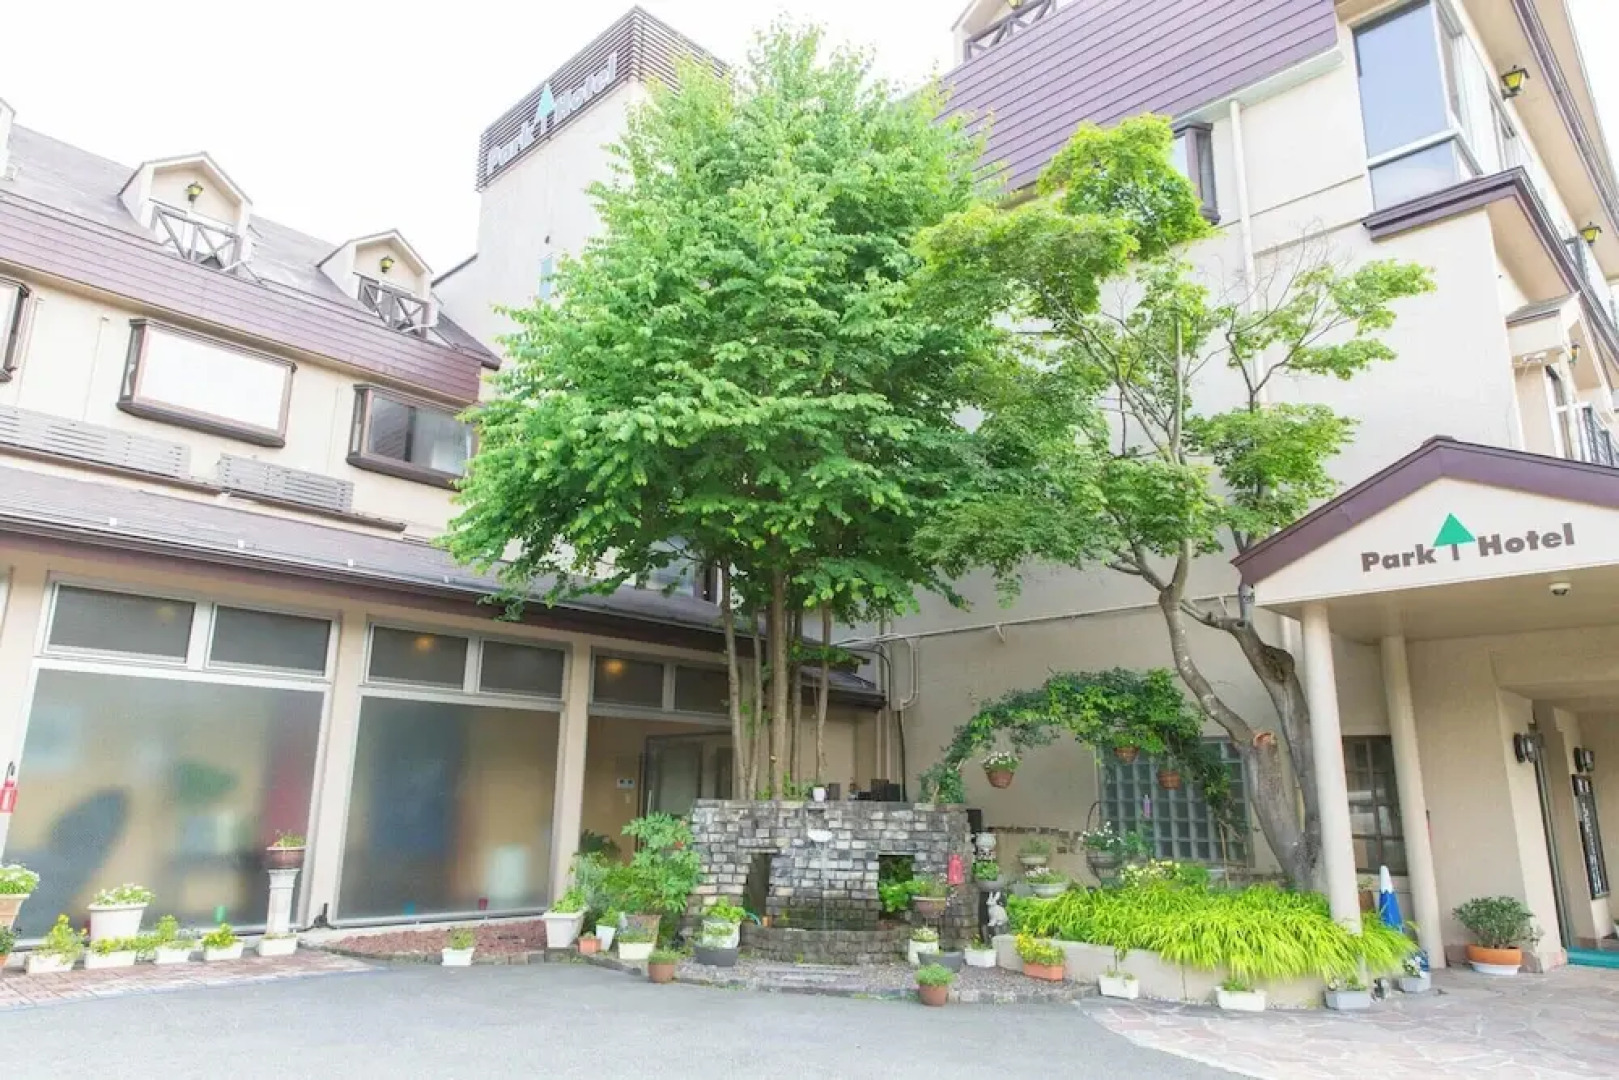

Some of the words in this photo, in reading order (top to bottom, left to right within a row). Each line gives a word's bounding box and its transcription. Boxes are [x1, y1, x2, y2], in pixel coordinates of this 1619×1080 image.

[487, 121, 535, 175] Park
[554, 50, 617, 124] Hotel
[1361, 544, 1436, 572] Park
[1478, 523, 1575, 557] Hotel
